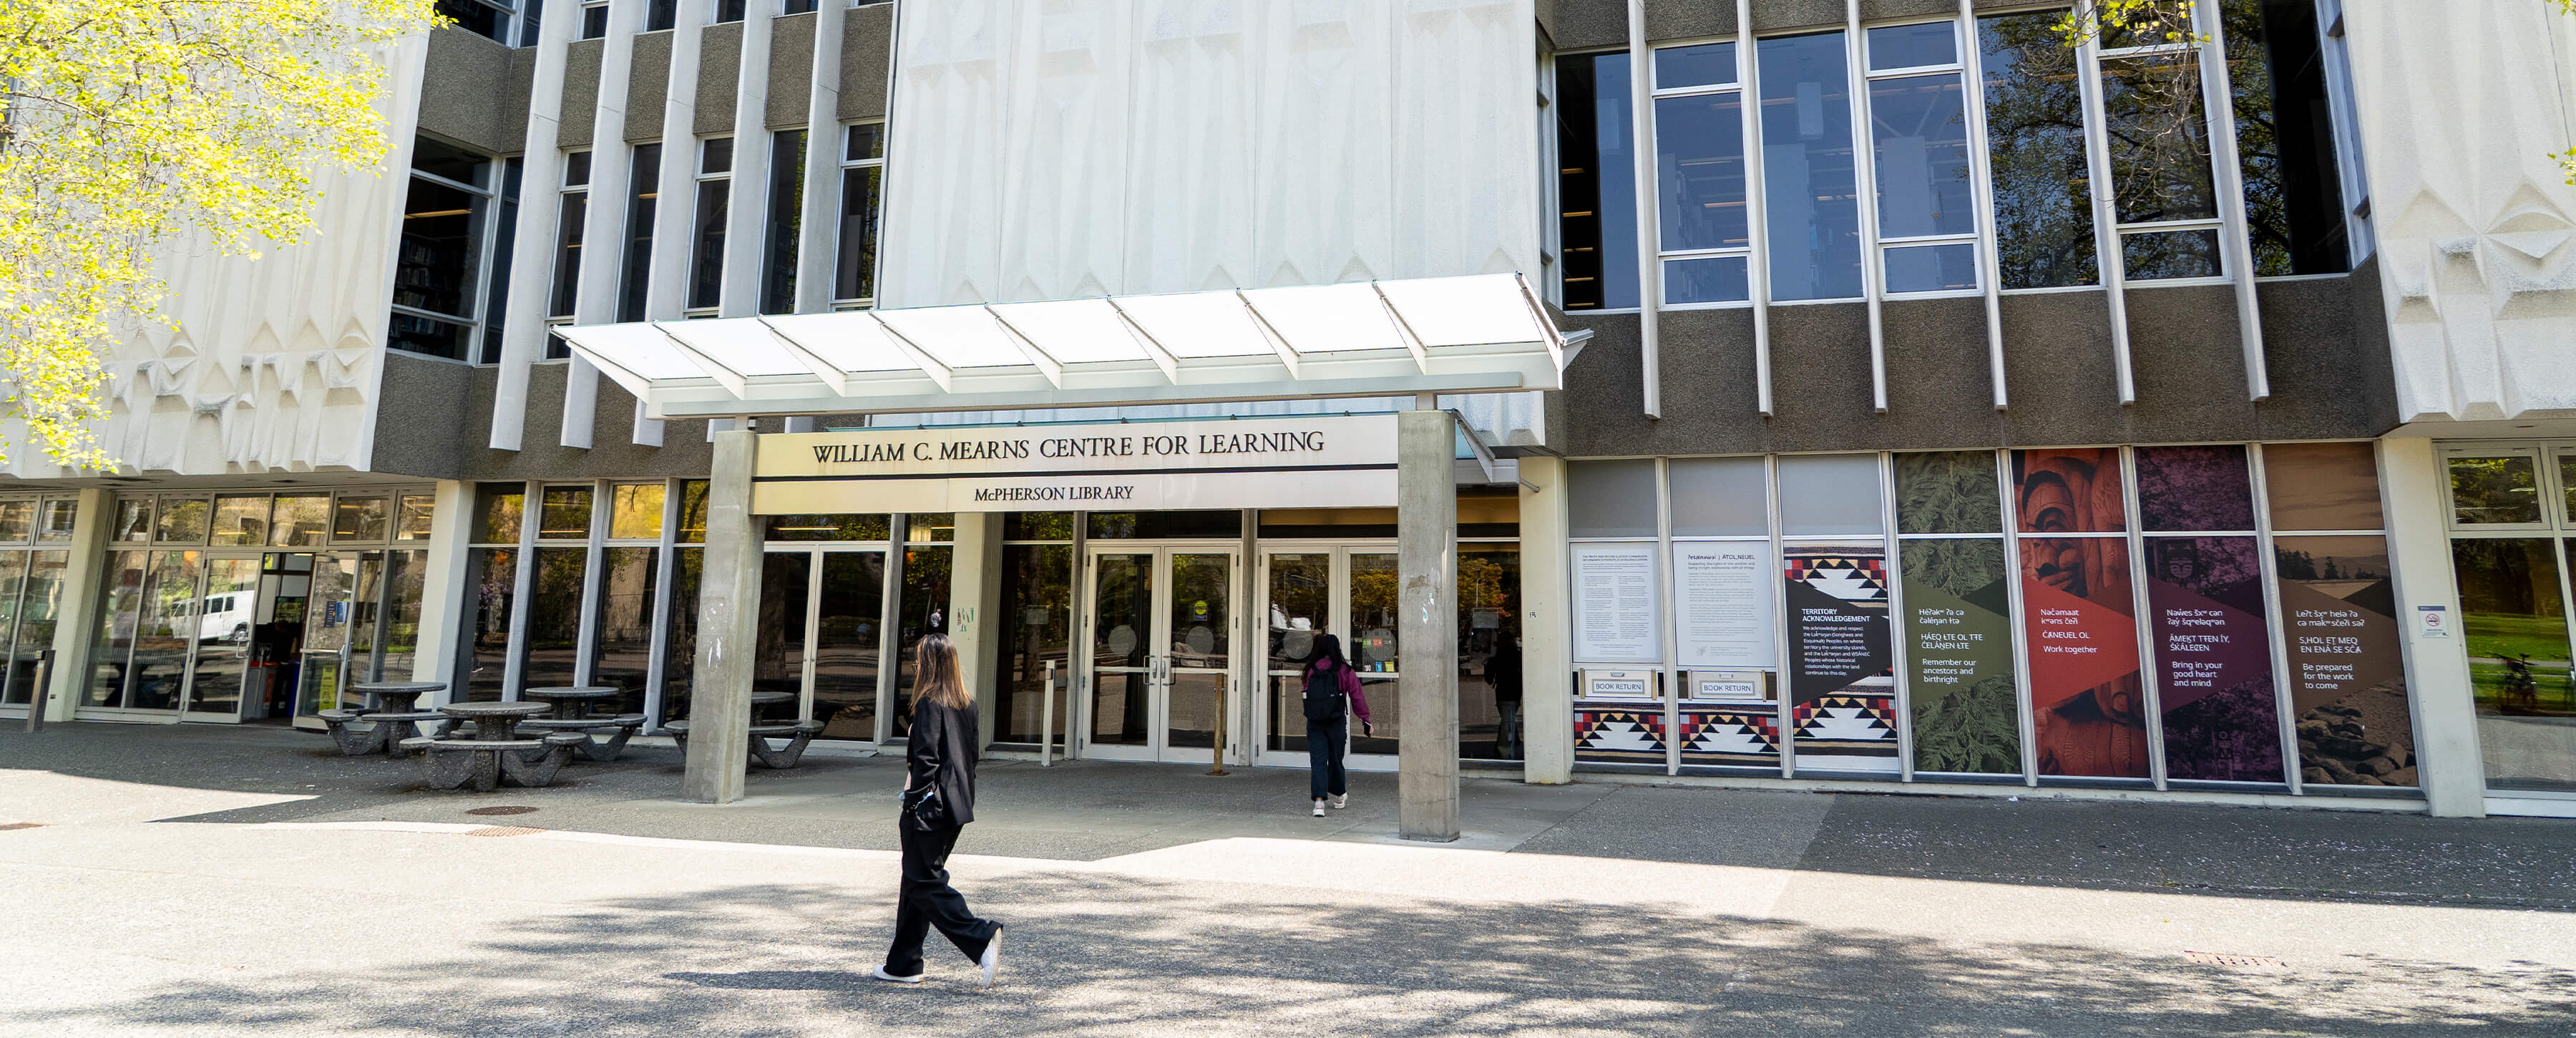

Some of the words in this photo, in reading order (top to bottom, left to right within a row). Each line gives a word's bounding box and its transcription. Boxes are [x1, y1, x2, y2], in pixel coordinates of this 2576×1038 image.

[813, 444, 905, 463] WILLIAM
[914, 442, 932, 461] C.
[939, 440, 1030, 460] MEARNS
[1040, 437, 1133, 459] CENTRE
[1142, 436, 1189, 455] FOR
[1199, 432, 1324, 454] LEARNING
[975, 488, 1065, 502] McPHERSON
[1069, 486, 1133, 500] LIBRARY
[1921, 632, 1941, 642] HÁEQ
[2338, 637, 2358, 646] MEQ
[2065, 646, 2097, 655] together
[2172, 661, 2193, 670] Bring
[2316, 664, 2352, 672] prepared
[2173, 670, 2193, 679] good
[1924, 676, 1958, 684] birthright
